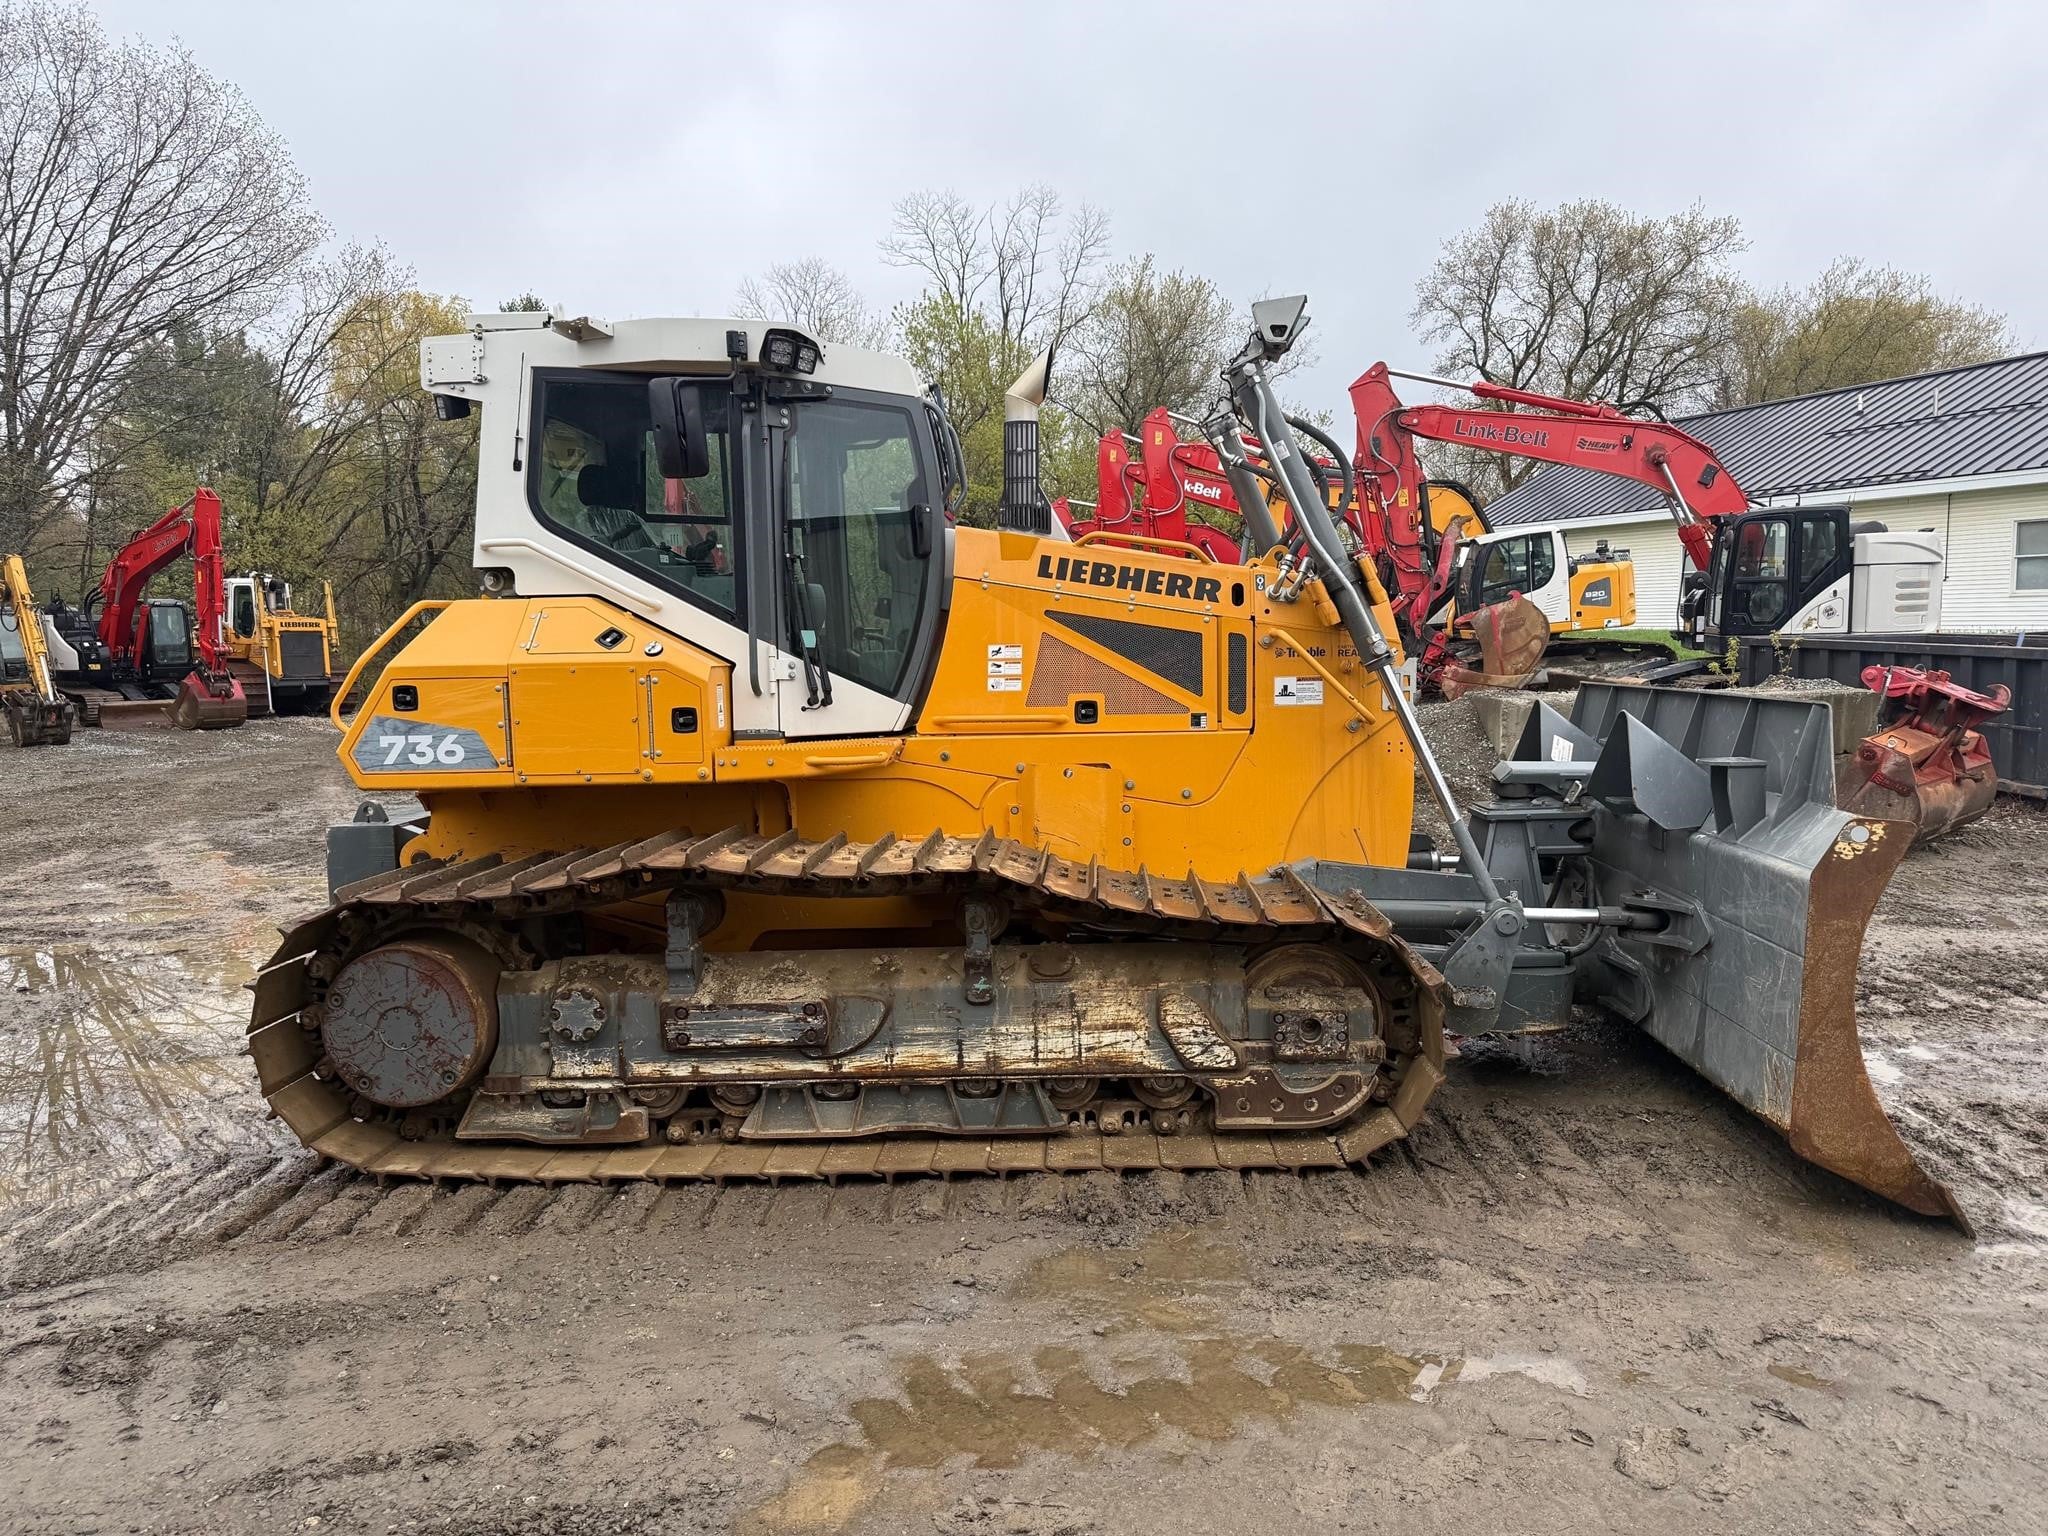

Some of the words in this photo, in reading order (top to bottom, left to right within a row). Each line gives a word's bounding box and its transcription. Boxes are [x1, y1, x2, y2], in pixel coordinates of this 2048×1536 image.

[1454, 418, 1549, 447] Link-Belt
[1184, 480, 1221, 499] k-Belt
[1037, 554, 1221, 603] LIEBHERR
[1287, 647, 1326, 658] Trble
[1338, 649, 1359, 657] REA
[379, 734, 465, 765] 736
